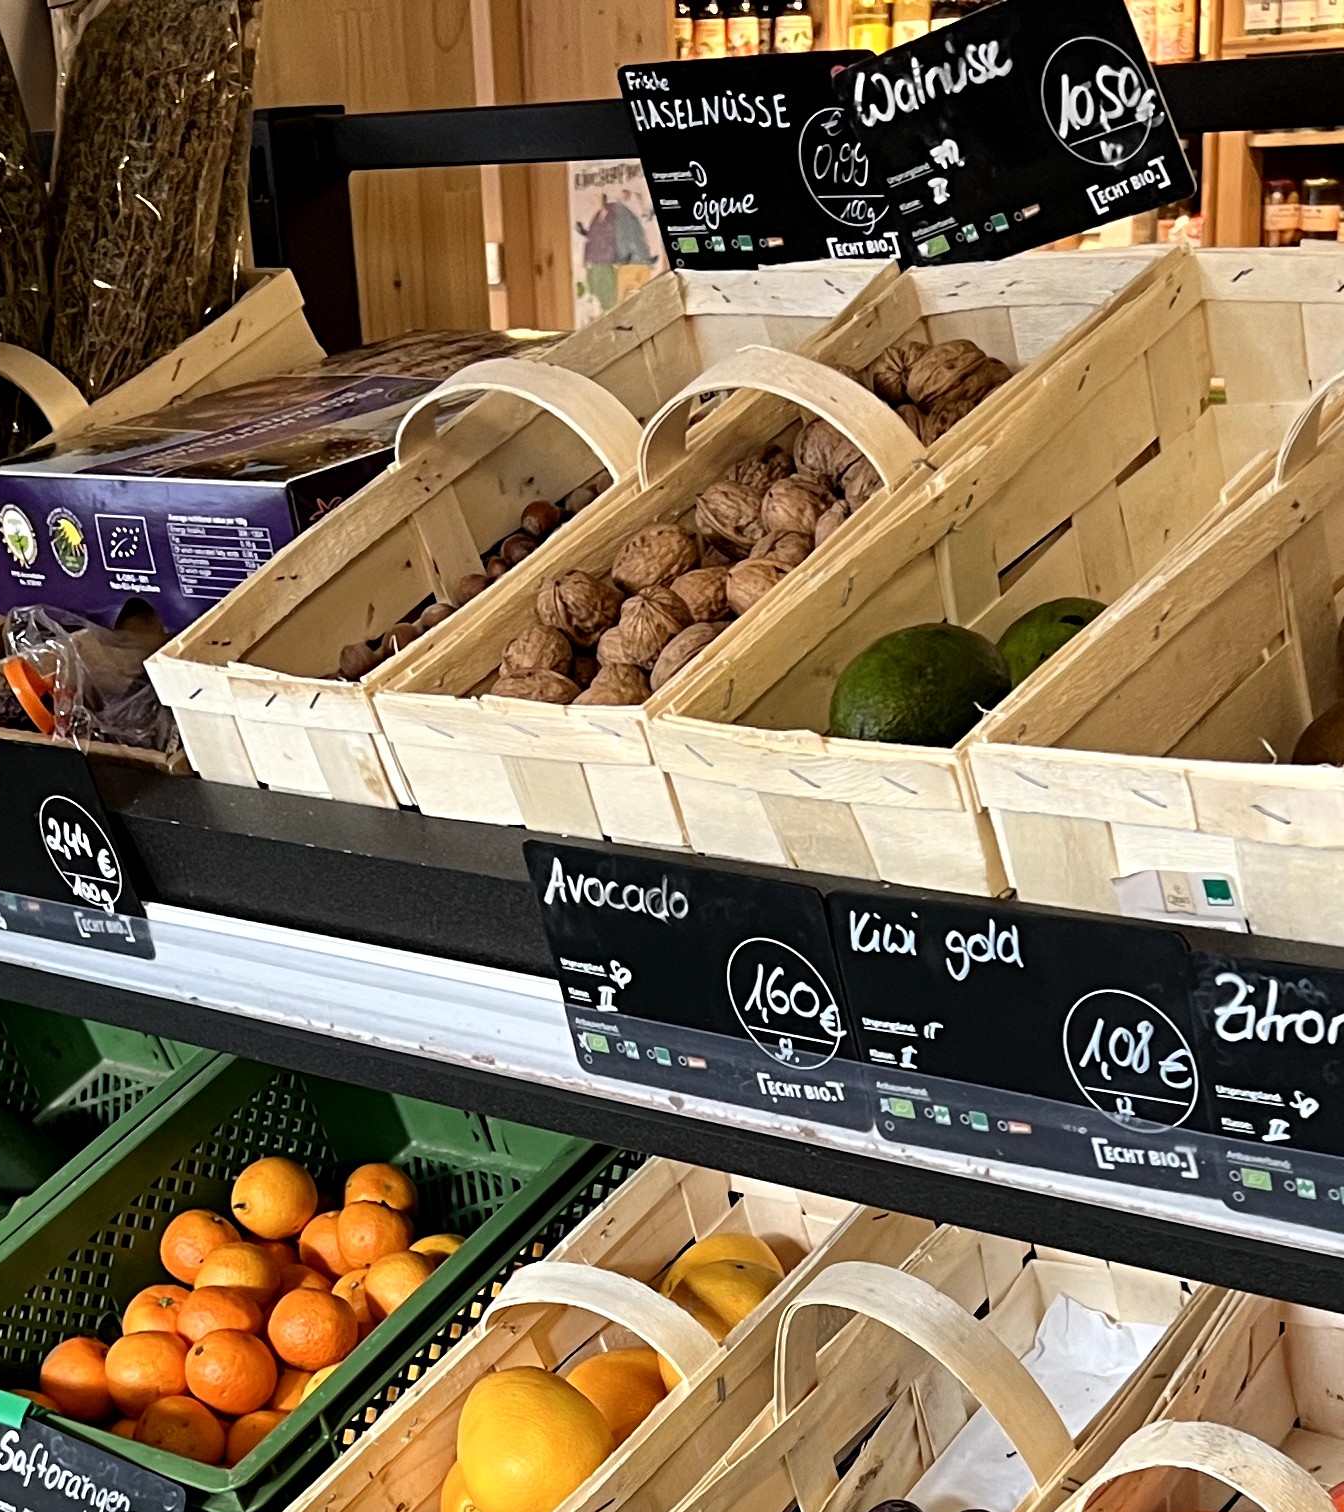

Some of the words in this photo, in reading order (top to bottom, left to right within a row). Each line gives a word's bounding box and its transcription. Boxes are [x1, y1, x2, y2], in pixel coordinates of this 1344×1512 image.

[625, 71, 670, 92] Frische
[630, 90, 791, 132] HASELNÜSSE
[692, 192, 759, 231] eigene
[544, 855, 689, 924] Avocado
[847, 909, 918, 958] Kiwi
[945, 924, 1025, 981] gold
